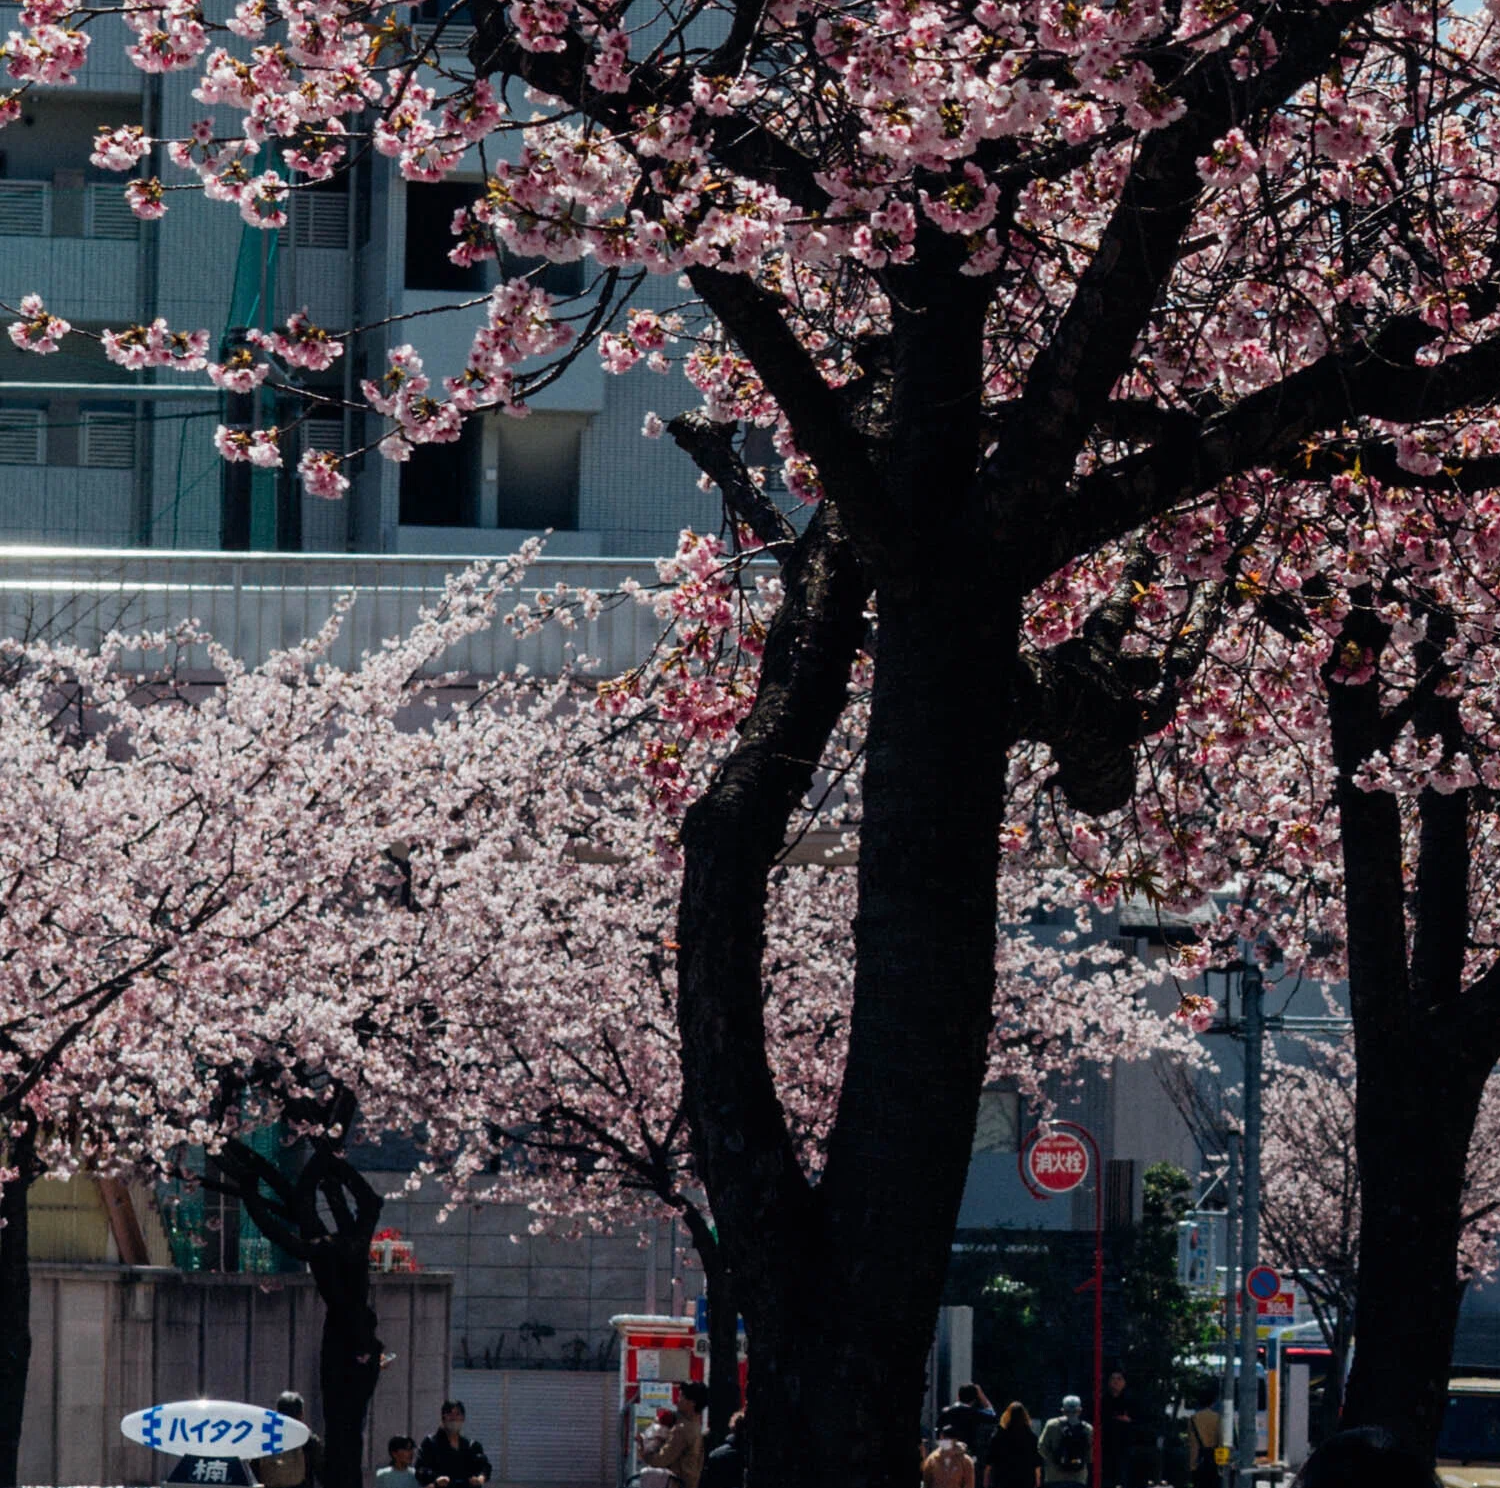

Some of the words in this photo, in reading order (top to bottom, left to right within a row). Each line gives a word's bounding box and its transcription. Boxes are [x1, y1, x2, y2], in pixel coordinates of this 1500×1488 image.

[1035, 1150, 1083, 1174] 消火栓
[169, 1417, 253, 1444] ハイタク
[192, 1459, 228, 1482] 楠
